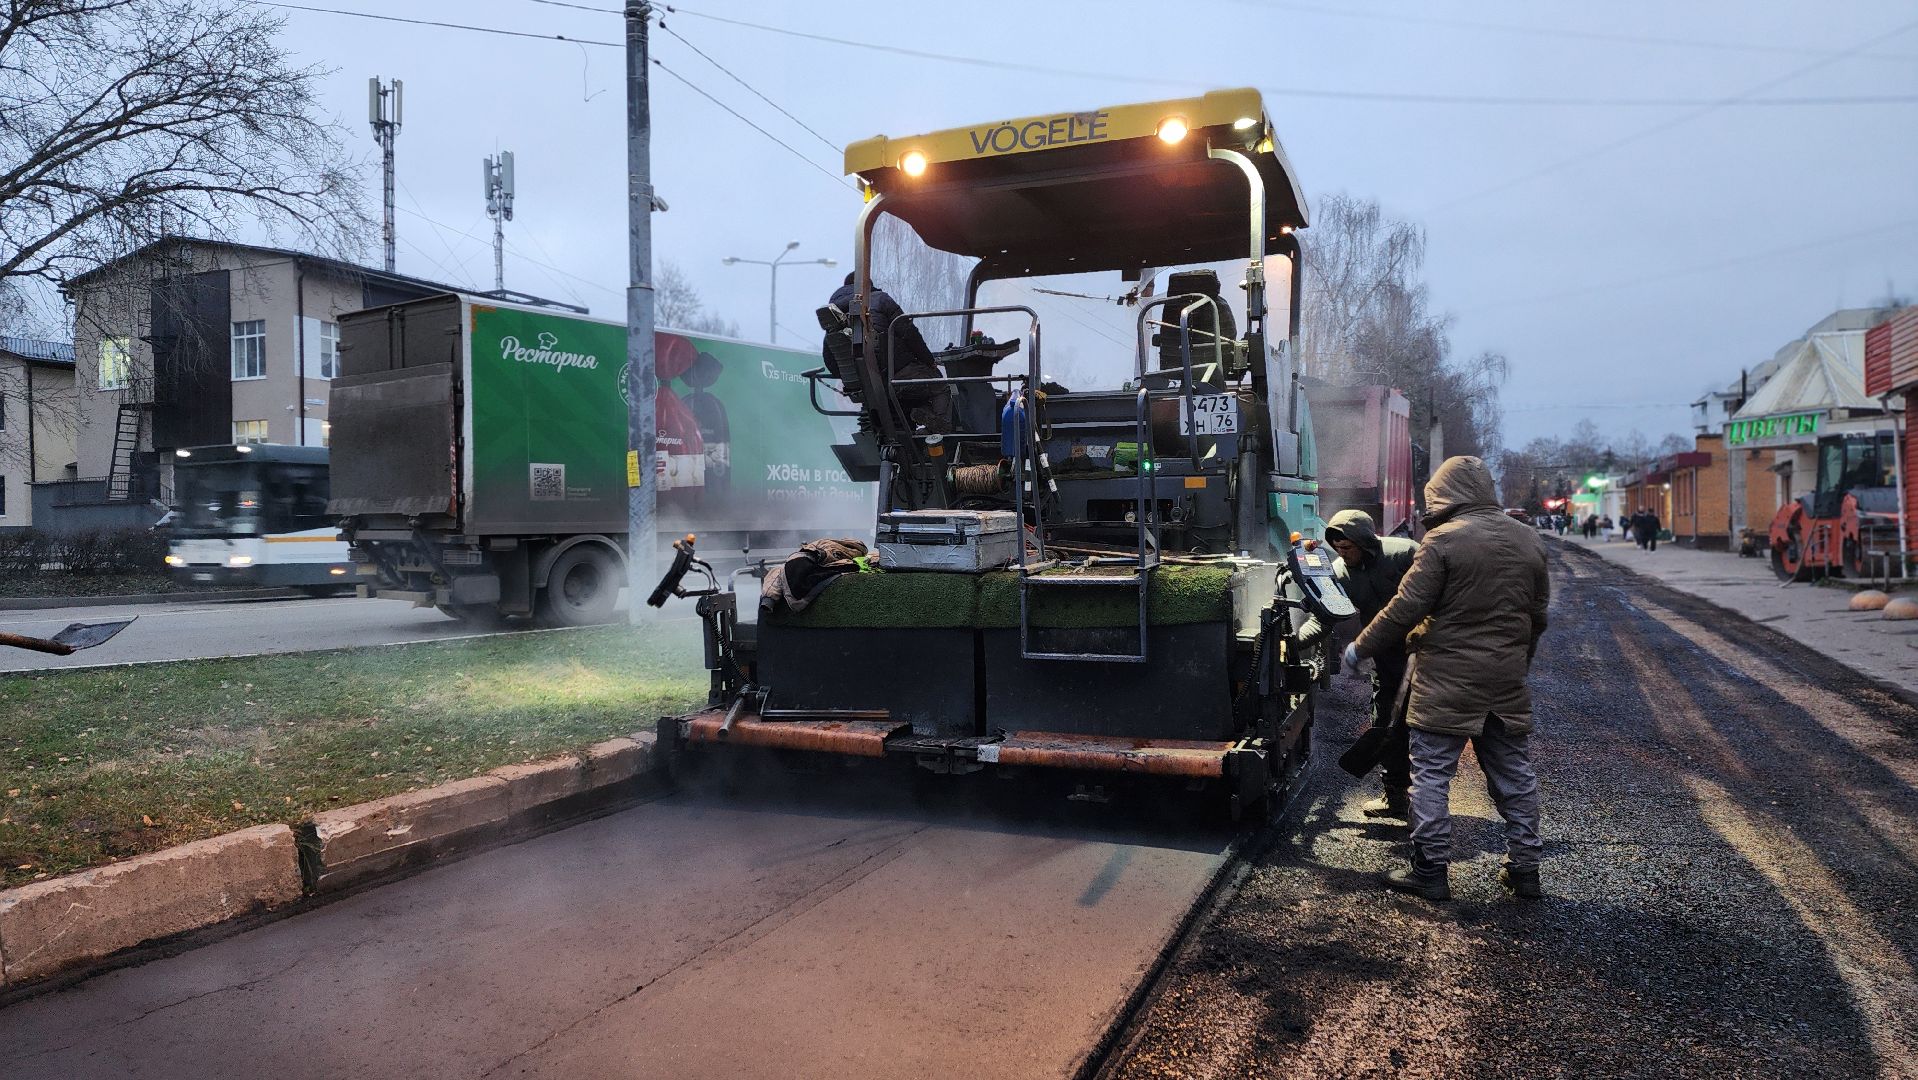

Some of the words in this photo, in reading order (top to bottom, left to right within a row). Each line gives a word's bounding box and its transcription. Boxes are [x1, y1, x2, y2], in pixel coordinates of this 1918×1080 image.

[970, 112, 1109, 154] VÖGELE
[500, 335, 599, 373] Рестория
[1216, 414, 1233, 428] 76
[1730, 412, 1819, 445] ЦВЕТЫ
[766, 463, 811, 482] Ждём
[814, 468, 823, 482] в
[825, 469, 853, 483] гос
